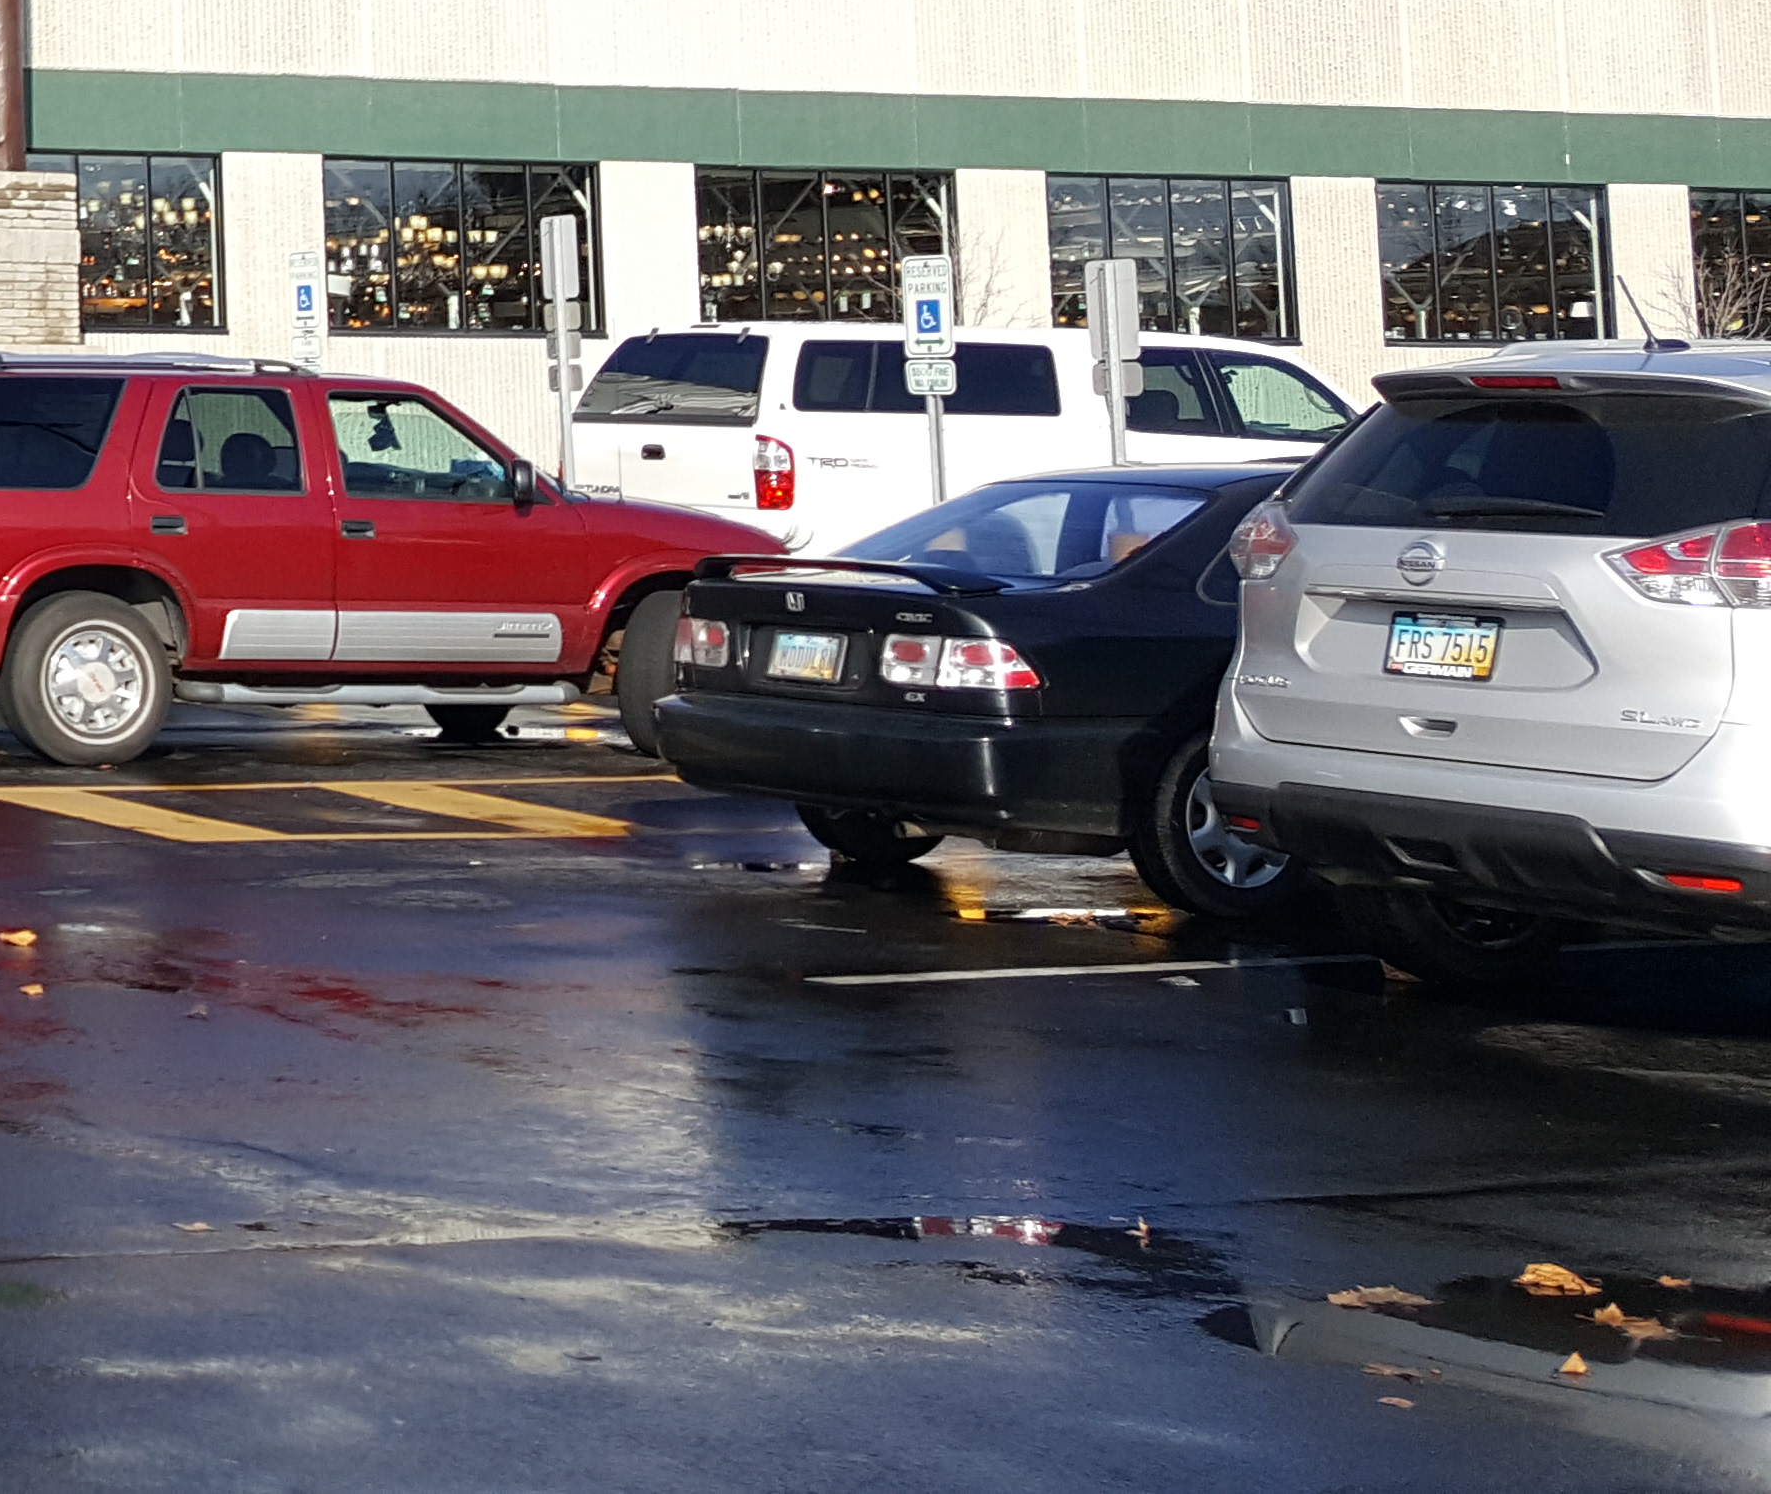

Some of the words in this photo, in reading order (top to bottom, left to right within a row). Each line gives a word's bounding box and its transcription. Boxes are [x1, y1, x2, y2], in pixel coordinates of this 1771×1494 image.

[906, 265, 948, 278] RESERVED
[907, 281, 947, 295] PARKING
[1395, 629, 1434, 659] FRS
[1440, 631, 1491, 663] 7515
[1403, 663, 1473, 678] GERMAIN
[1620, 709, 1656, 724] SL
